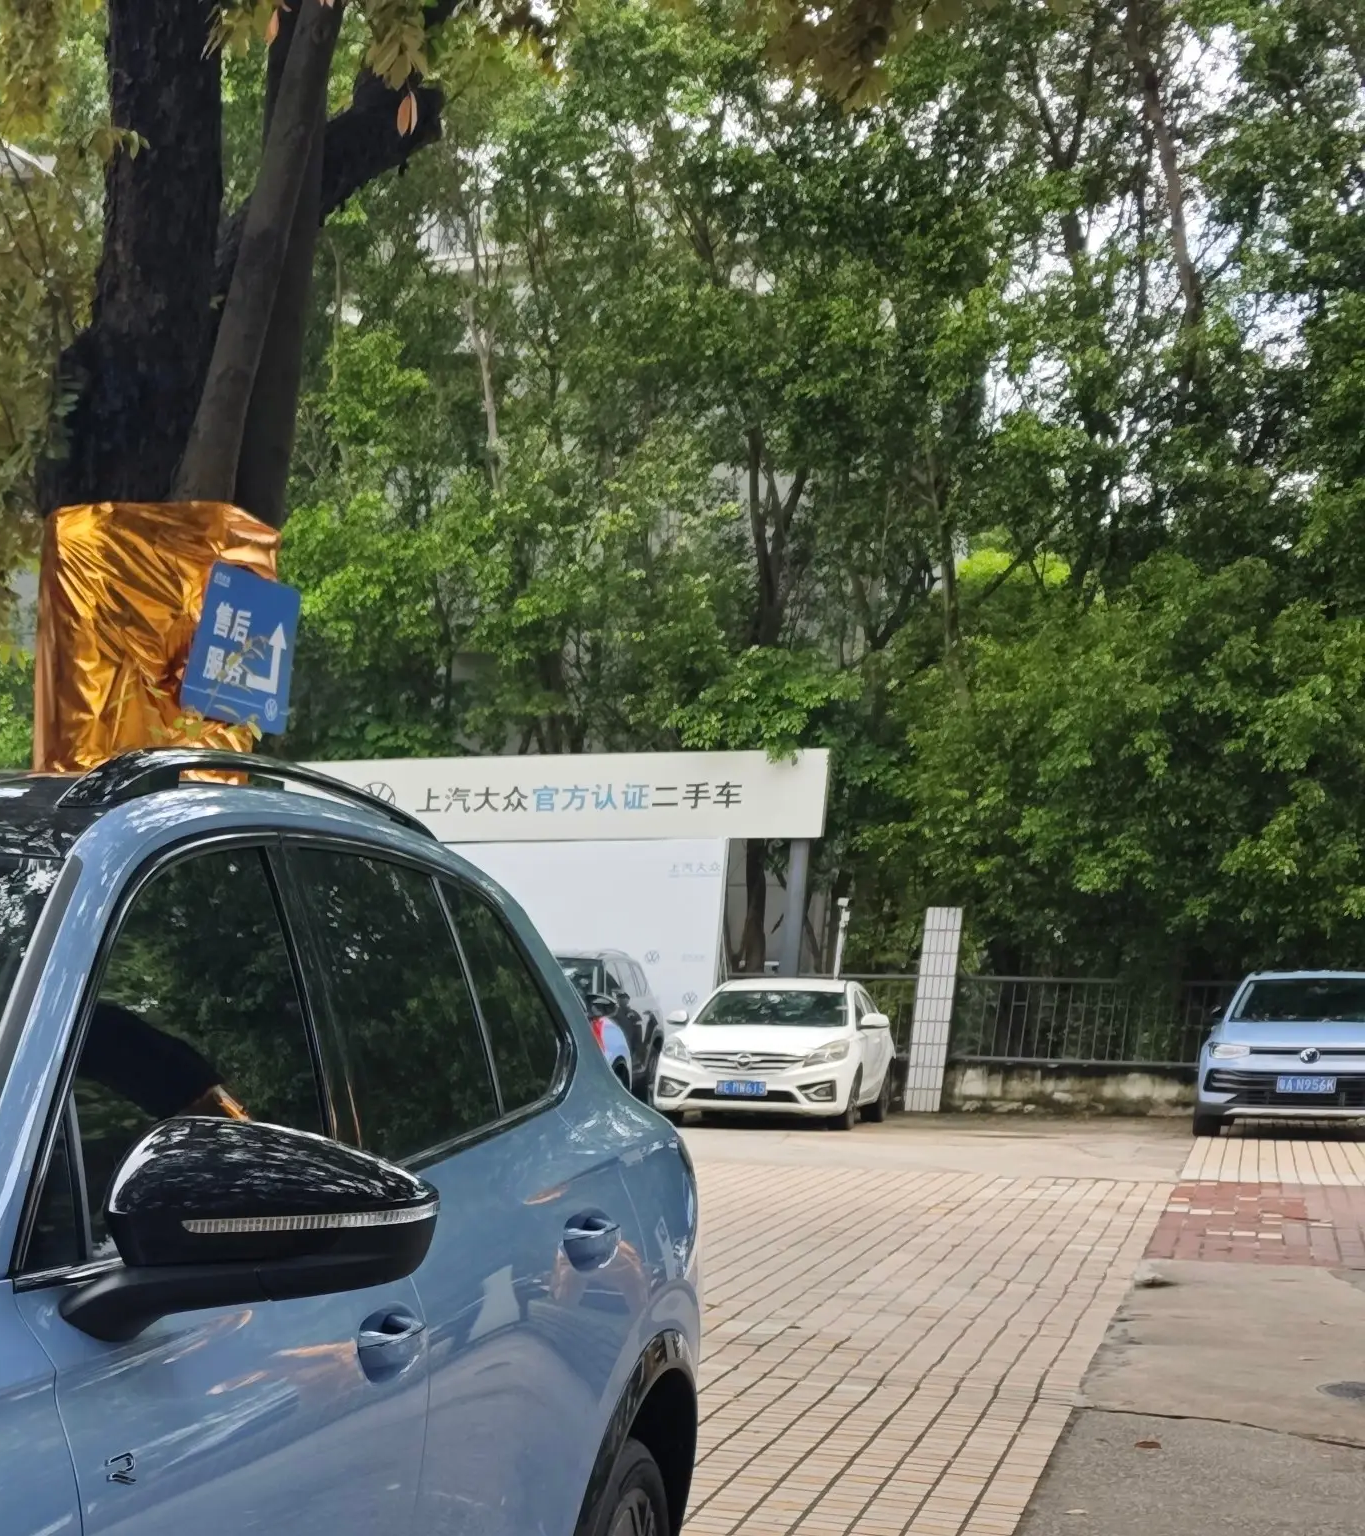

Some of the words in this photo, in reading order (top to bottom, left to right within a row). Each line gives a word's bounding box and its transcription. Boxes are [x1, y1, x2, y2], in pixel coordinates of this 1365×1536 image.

[213, 601, 252, 644] 售后
[416, 781, 743, 813] 上汽大众官方认证二手车
